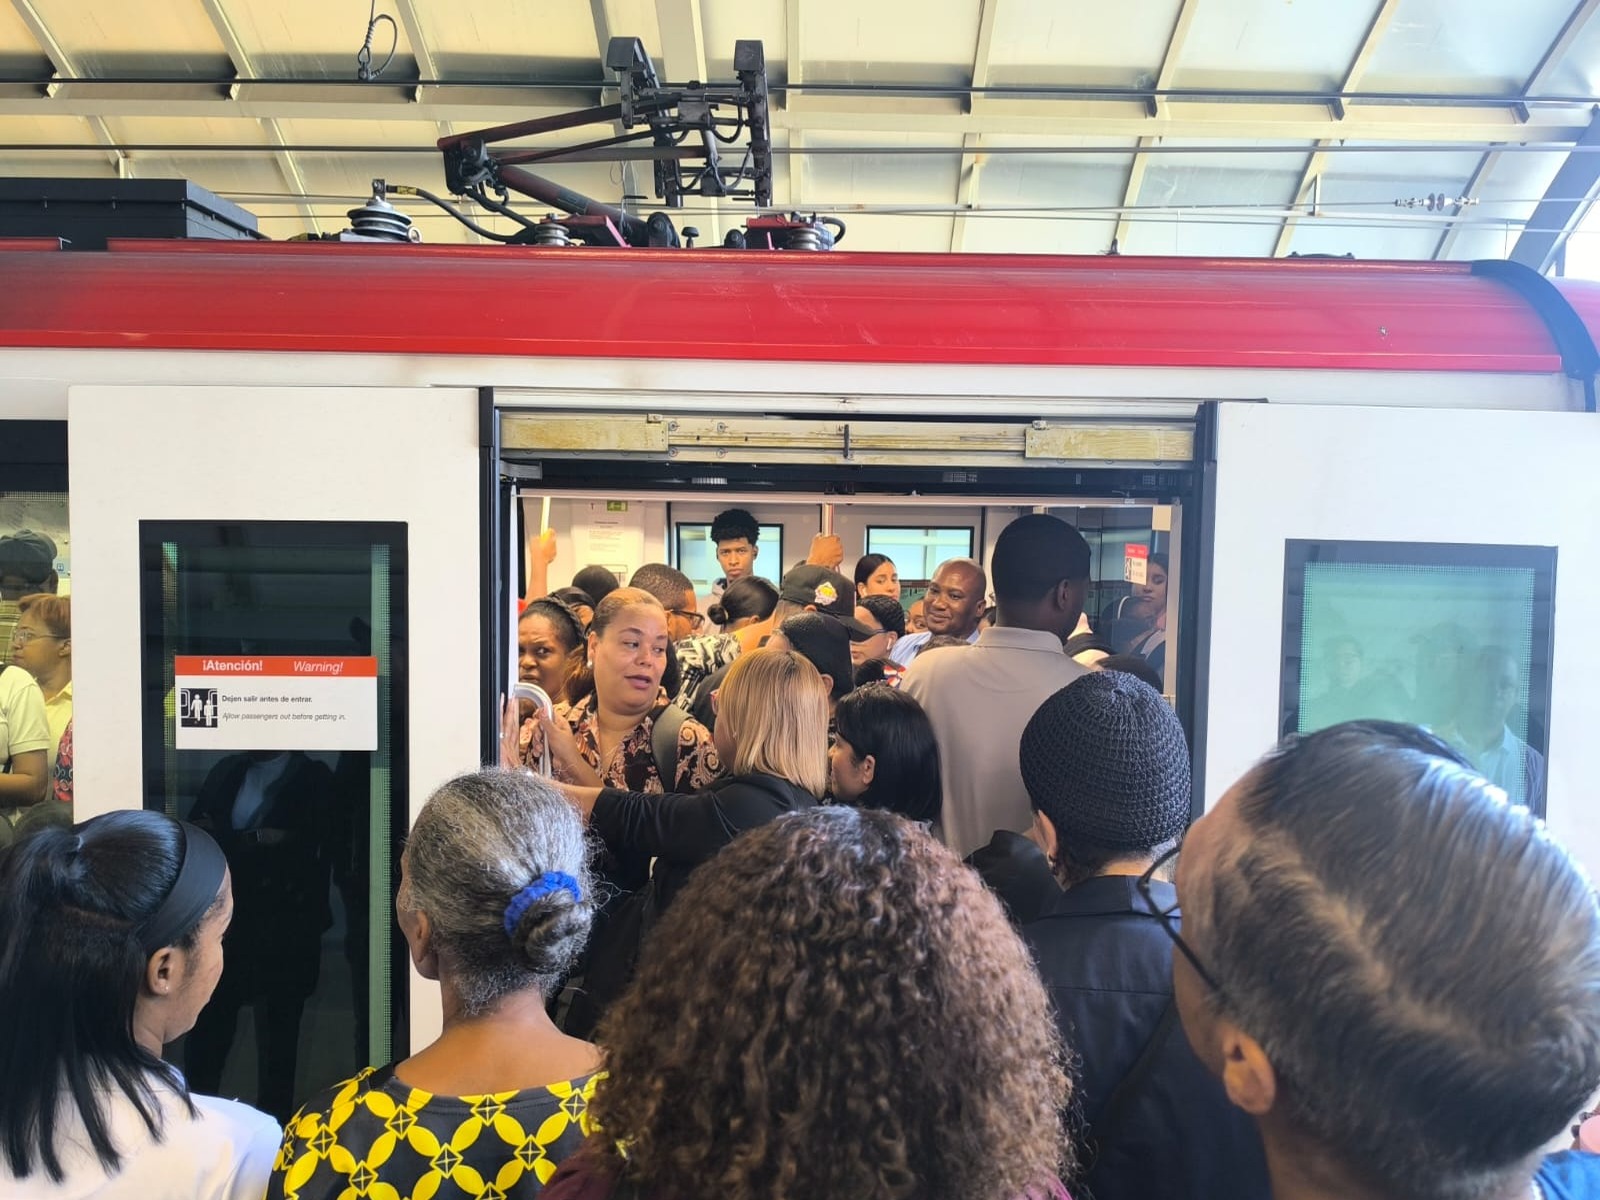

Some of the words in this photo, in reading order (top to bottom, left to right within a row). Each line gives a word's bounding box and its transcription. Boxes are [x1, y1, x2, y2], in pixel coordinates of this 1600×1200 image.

[202, 660, 263, 672] ¡Atención!
[293, 661, 344, 675] Warning!
[221, 695, 242, 703] Dejen
[222, 712, 240, 721] Allow
[241, 713, 279, 721] passengers
[314, 714, 337, 722] getting
